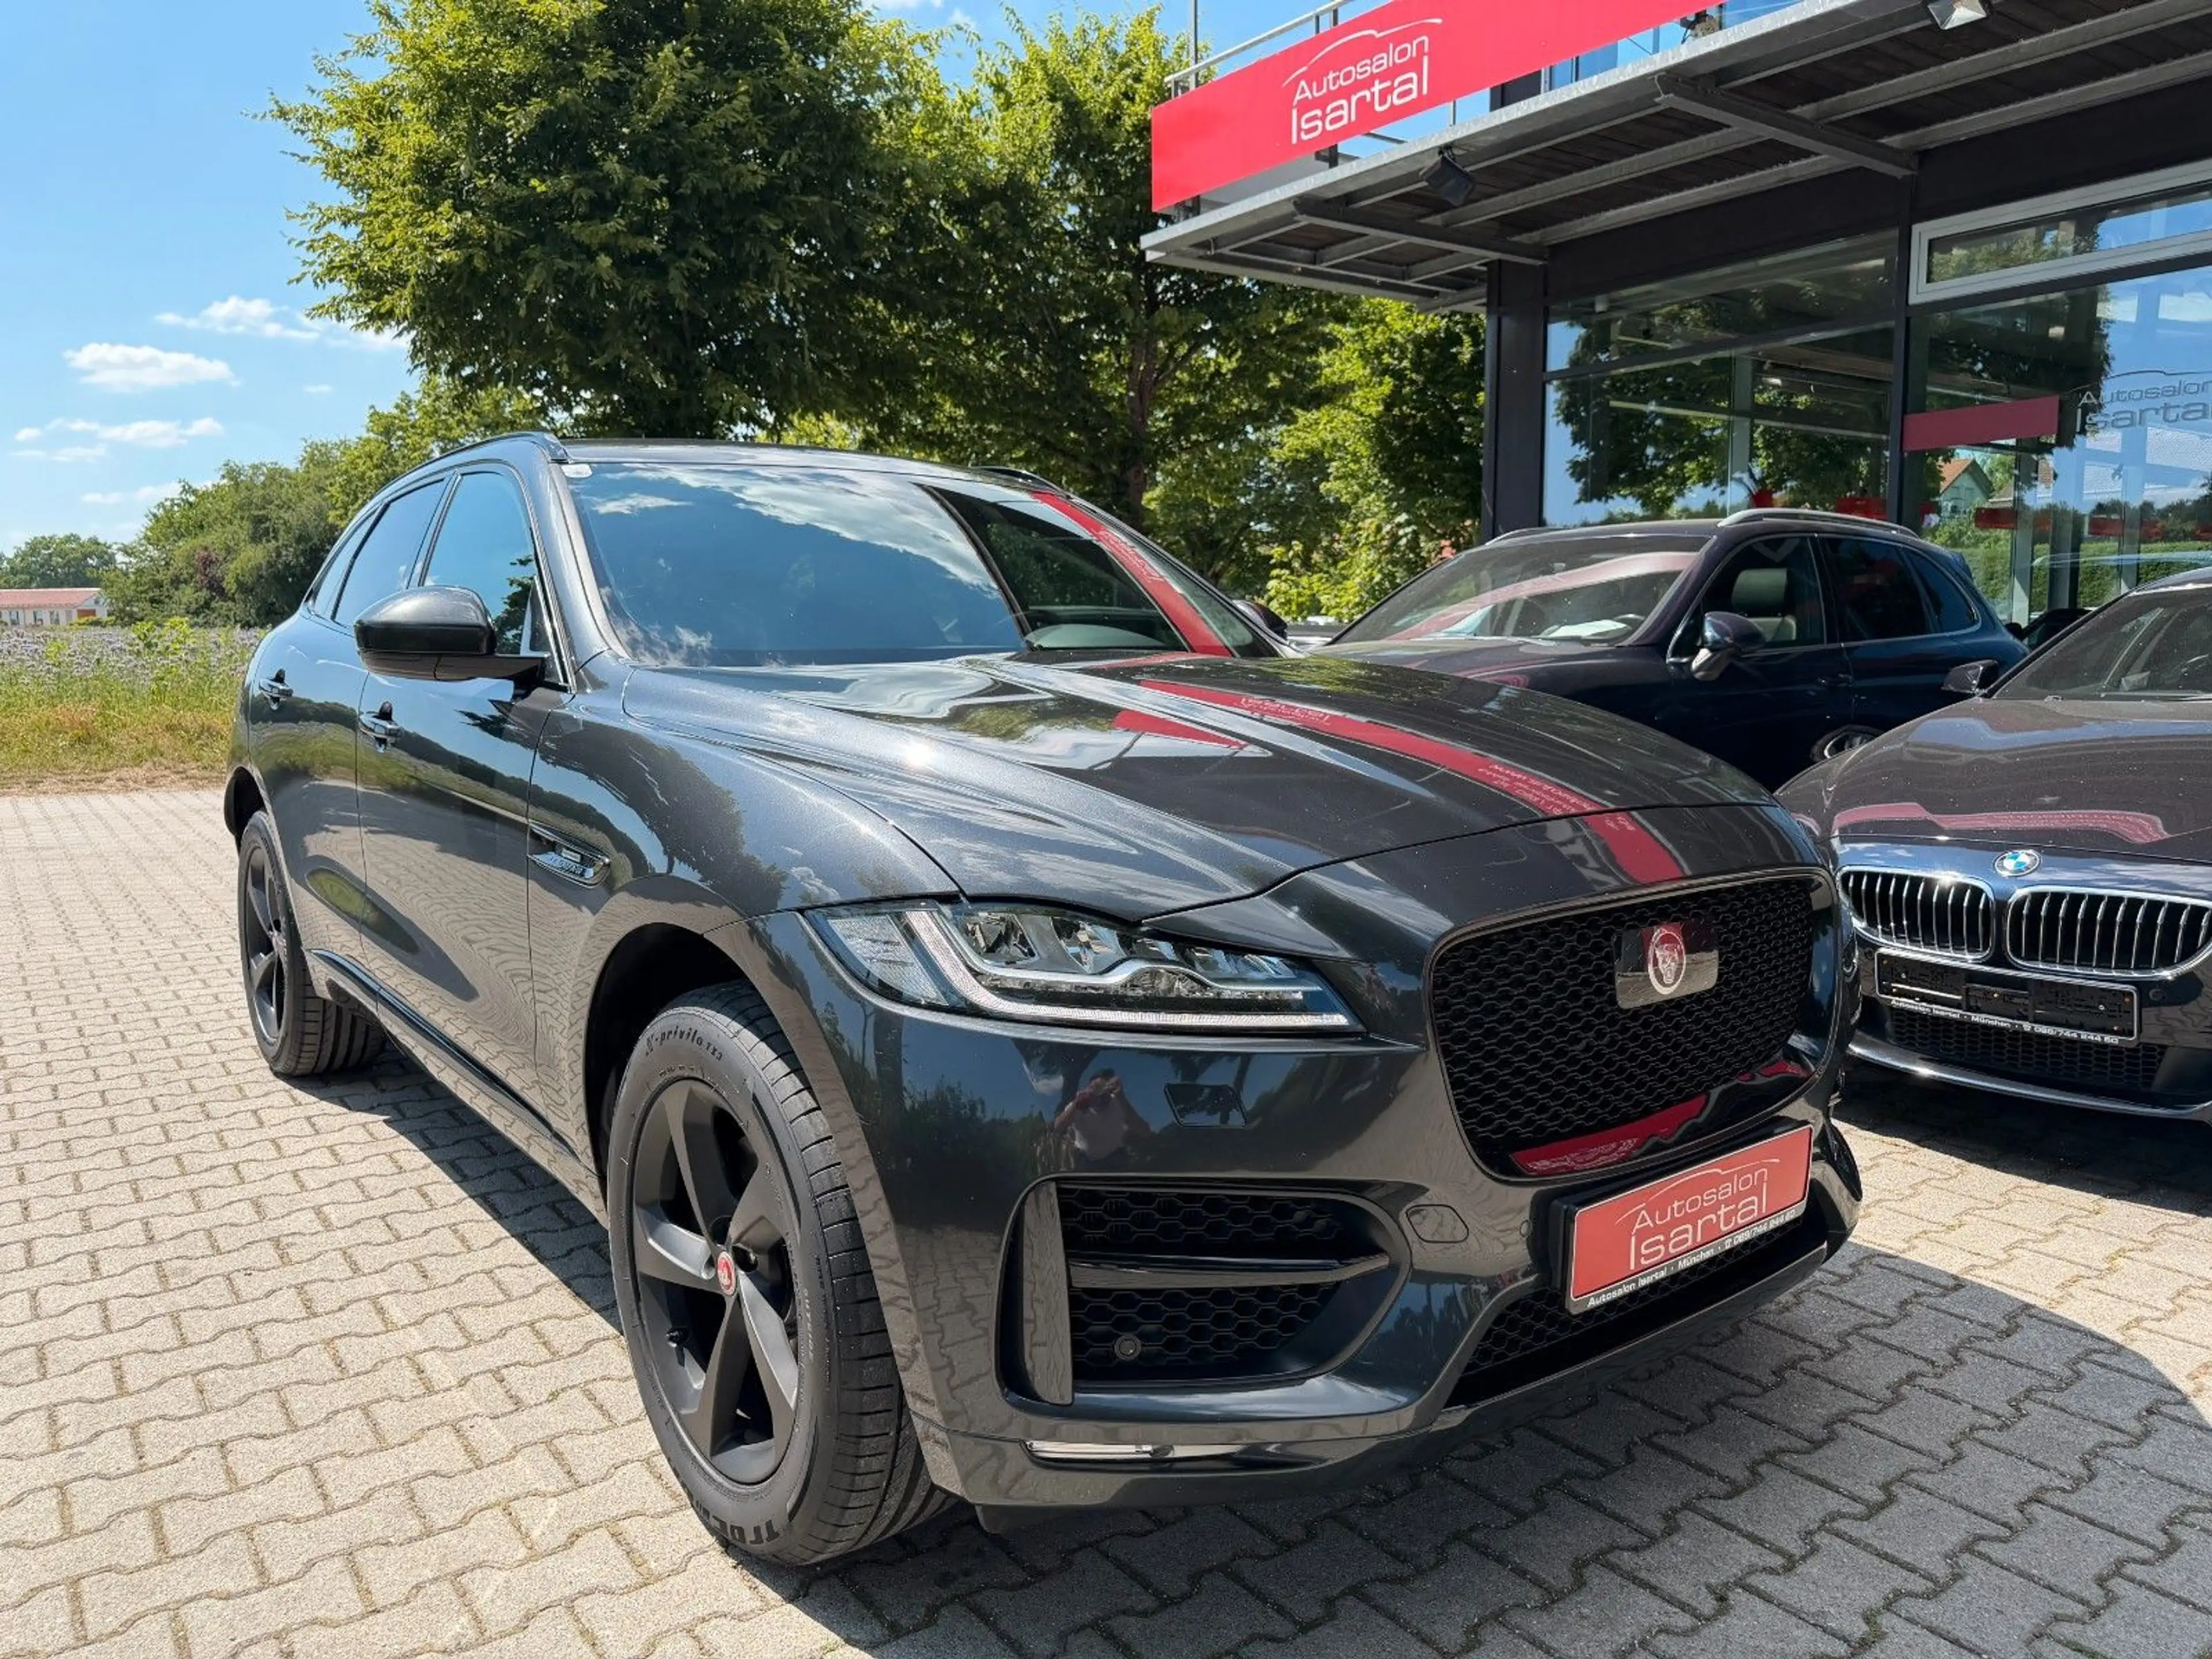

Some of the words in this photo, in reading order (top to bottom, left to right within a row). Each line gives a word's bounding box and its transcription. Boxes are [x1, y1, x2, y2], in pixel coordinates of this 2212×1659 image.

[1291, 55, 1429, 144] Isartal
[1293, 36, 1429, 106] Autosalon
[2075, 402, 2212, 432] Isarta
[1630, 1183, 1767, 1270] Isartal
[1631, 1168, 1768, 1235] Autosalon
[1587, 1282, 1635, 1308] Autosalon
[1638, 1267, 1667, 1287] Isartal
